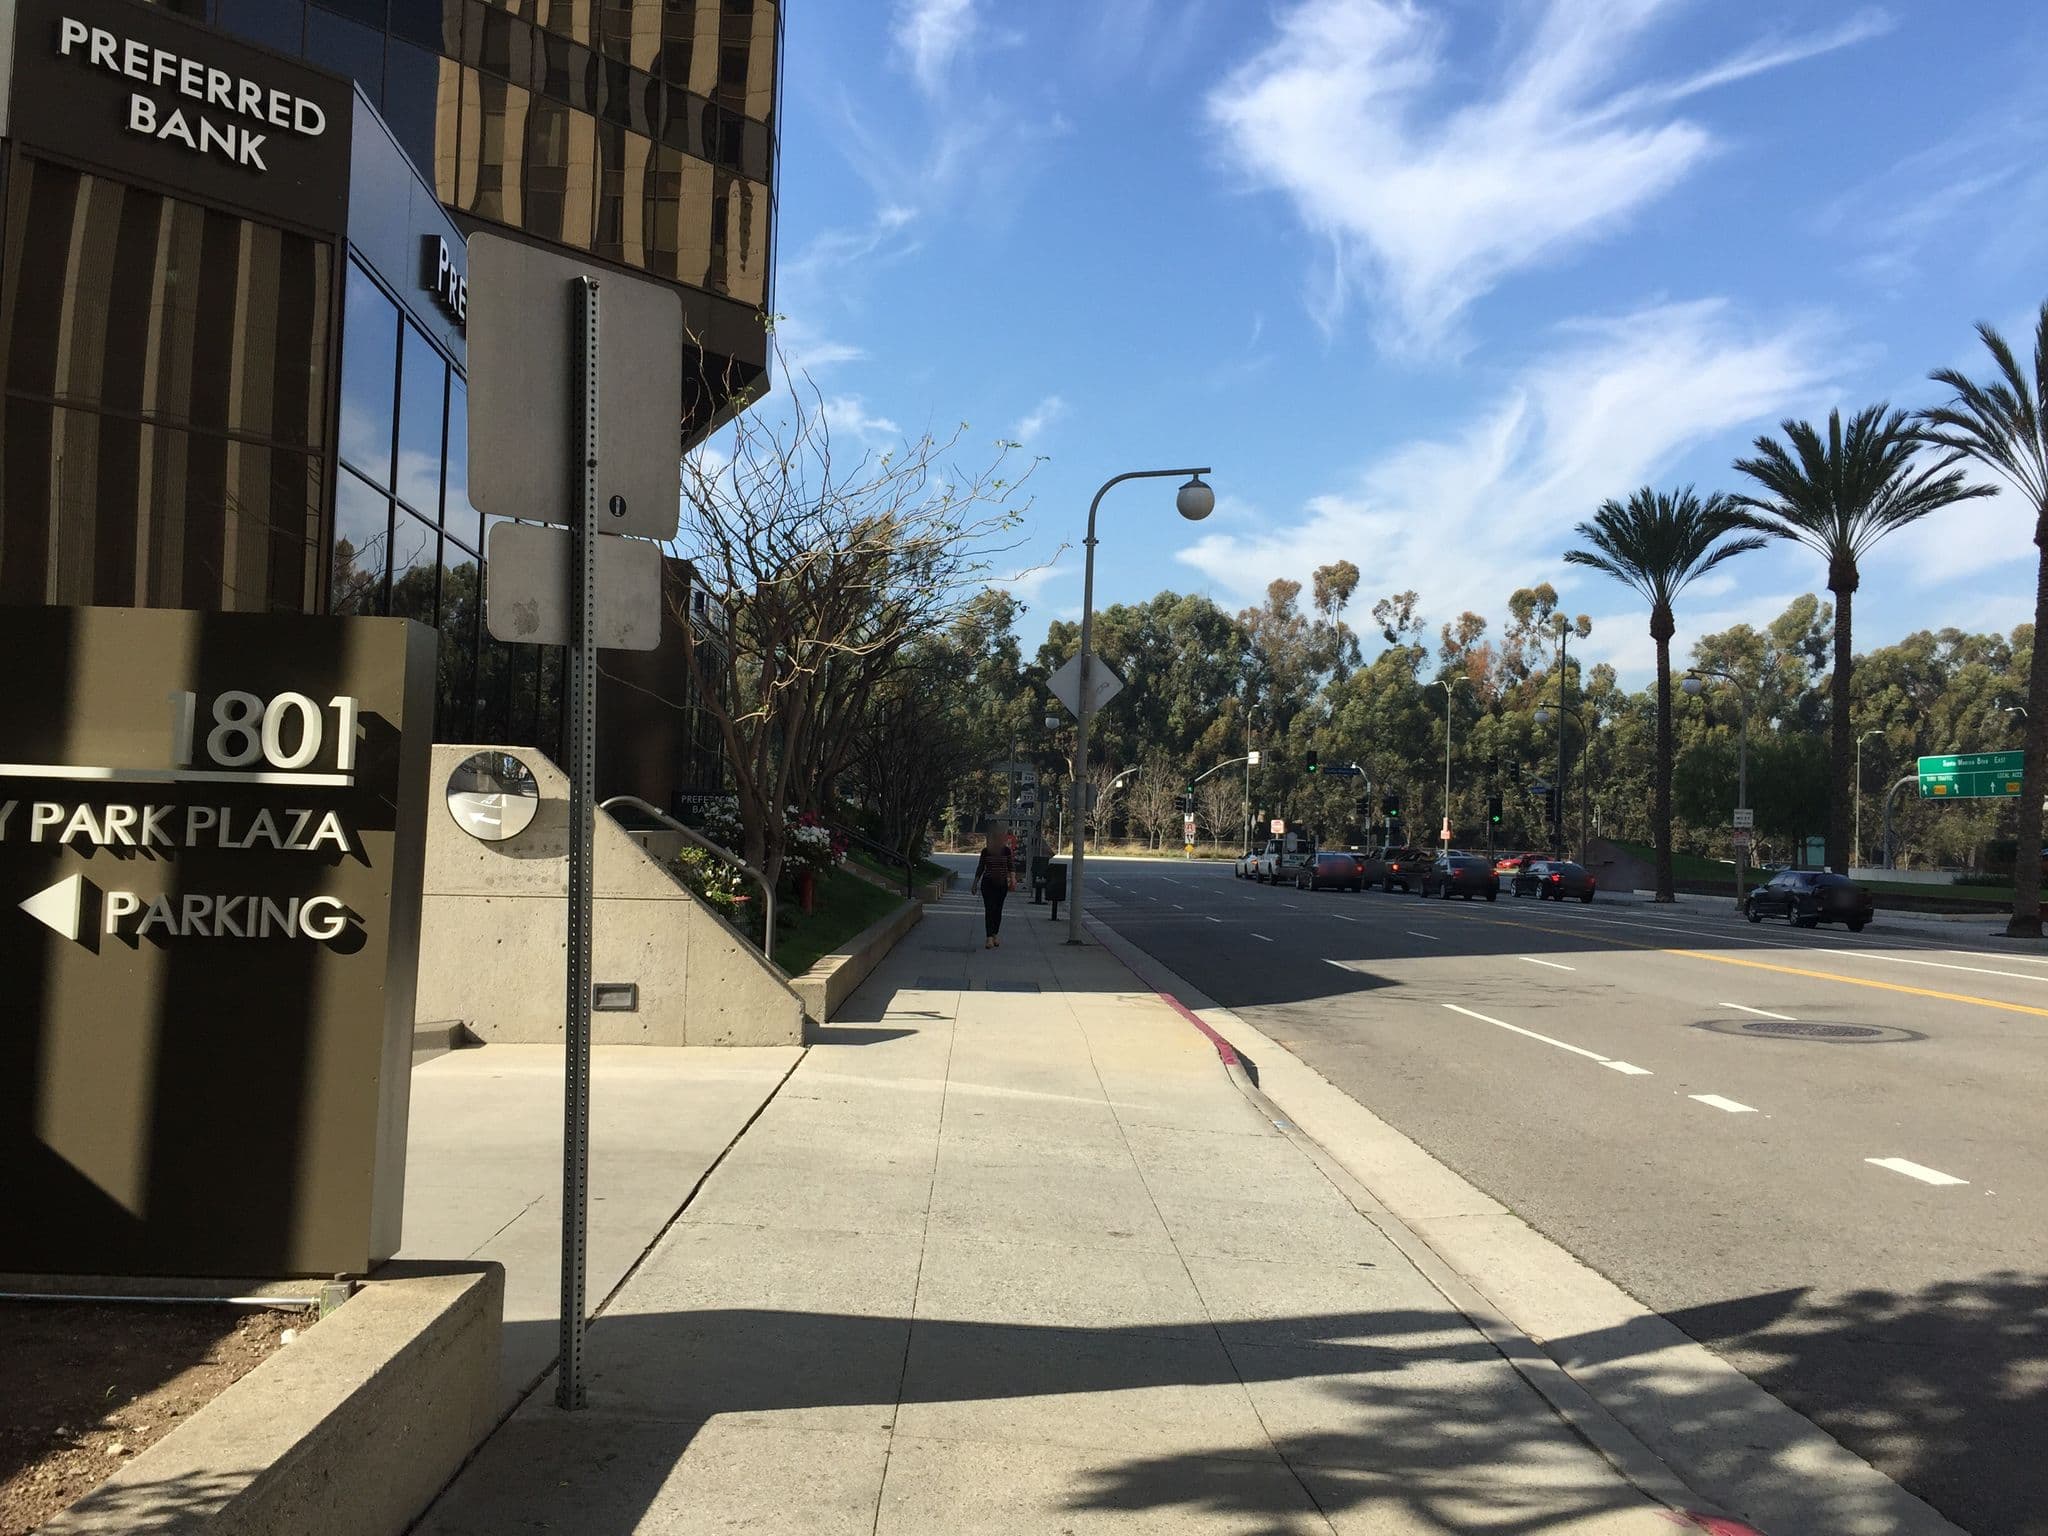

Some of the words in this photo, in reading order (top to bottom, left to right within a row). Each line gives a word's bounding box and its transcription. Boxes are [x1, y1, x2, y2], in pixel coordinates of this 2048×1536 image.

[59, 16, 327, 137] PREFERRED
[128, 92, 269, 171] BANK
[168, 689, 359, 771] 1801
[30, 802, 177, 847] PARK
[185, 805, 352, 853] PLAZA
[106, 890, 348, 941] PARKING
